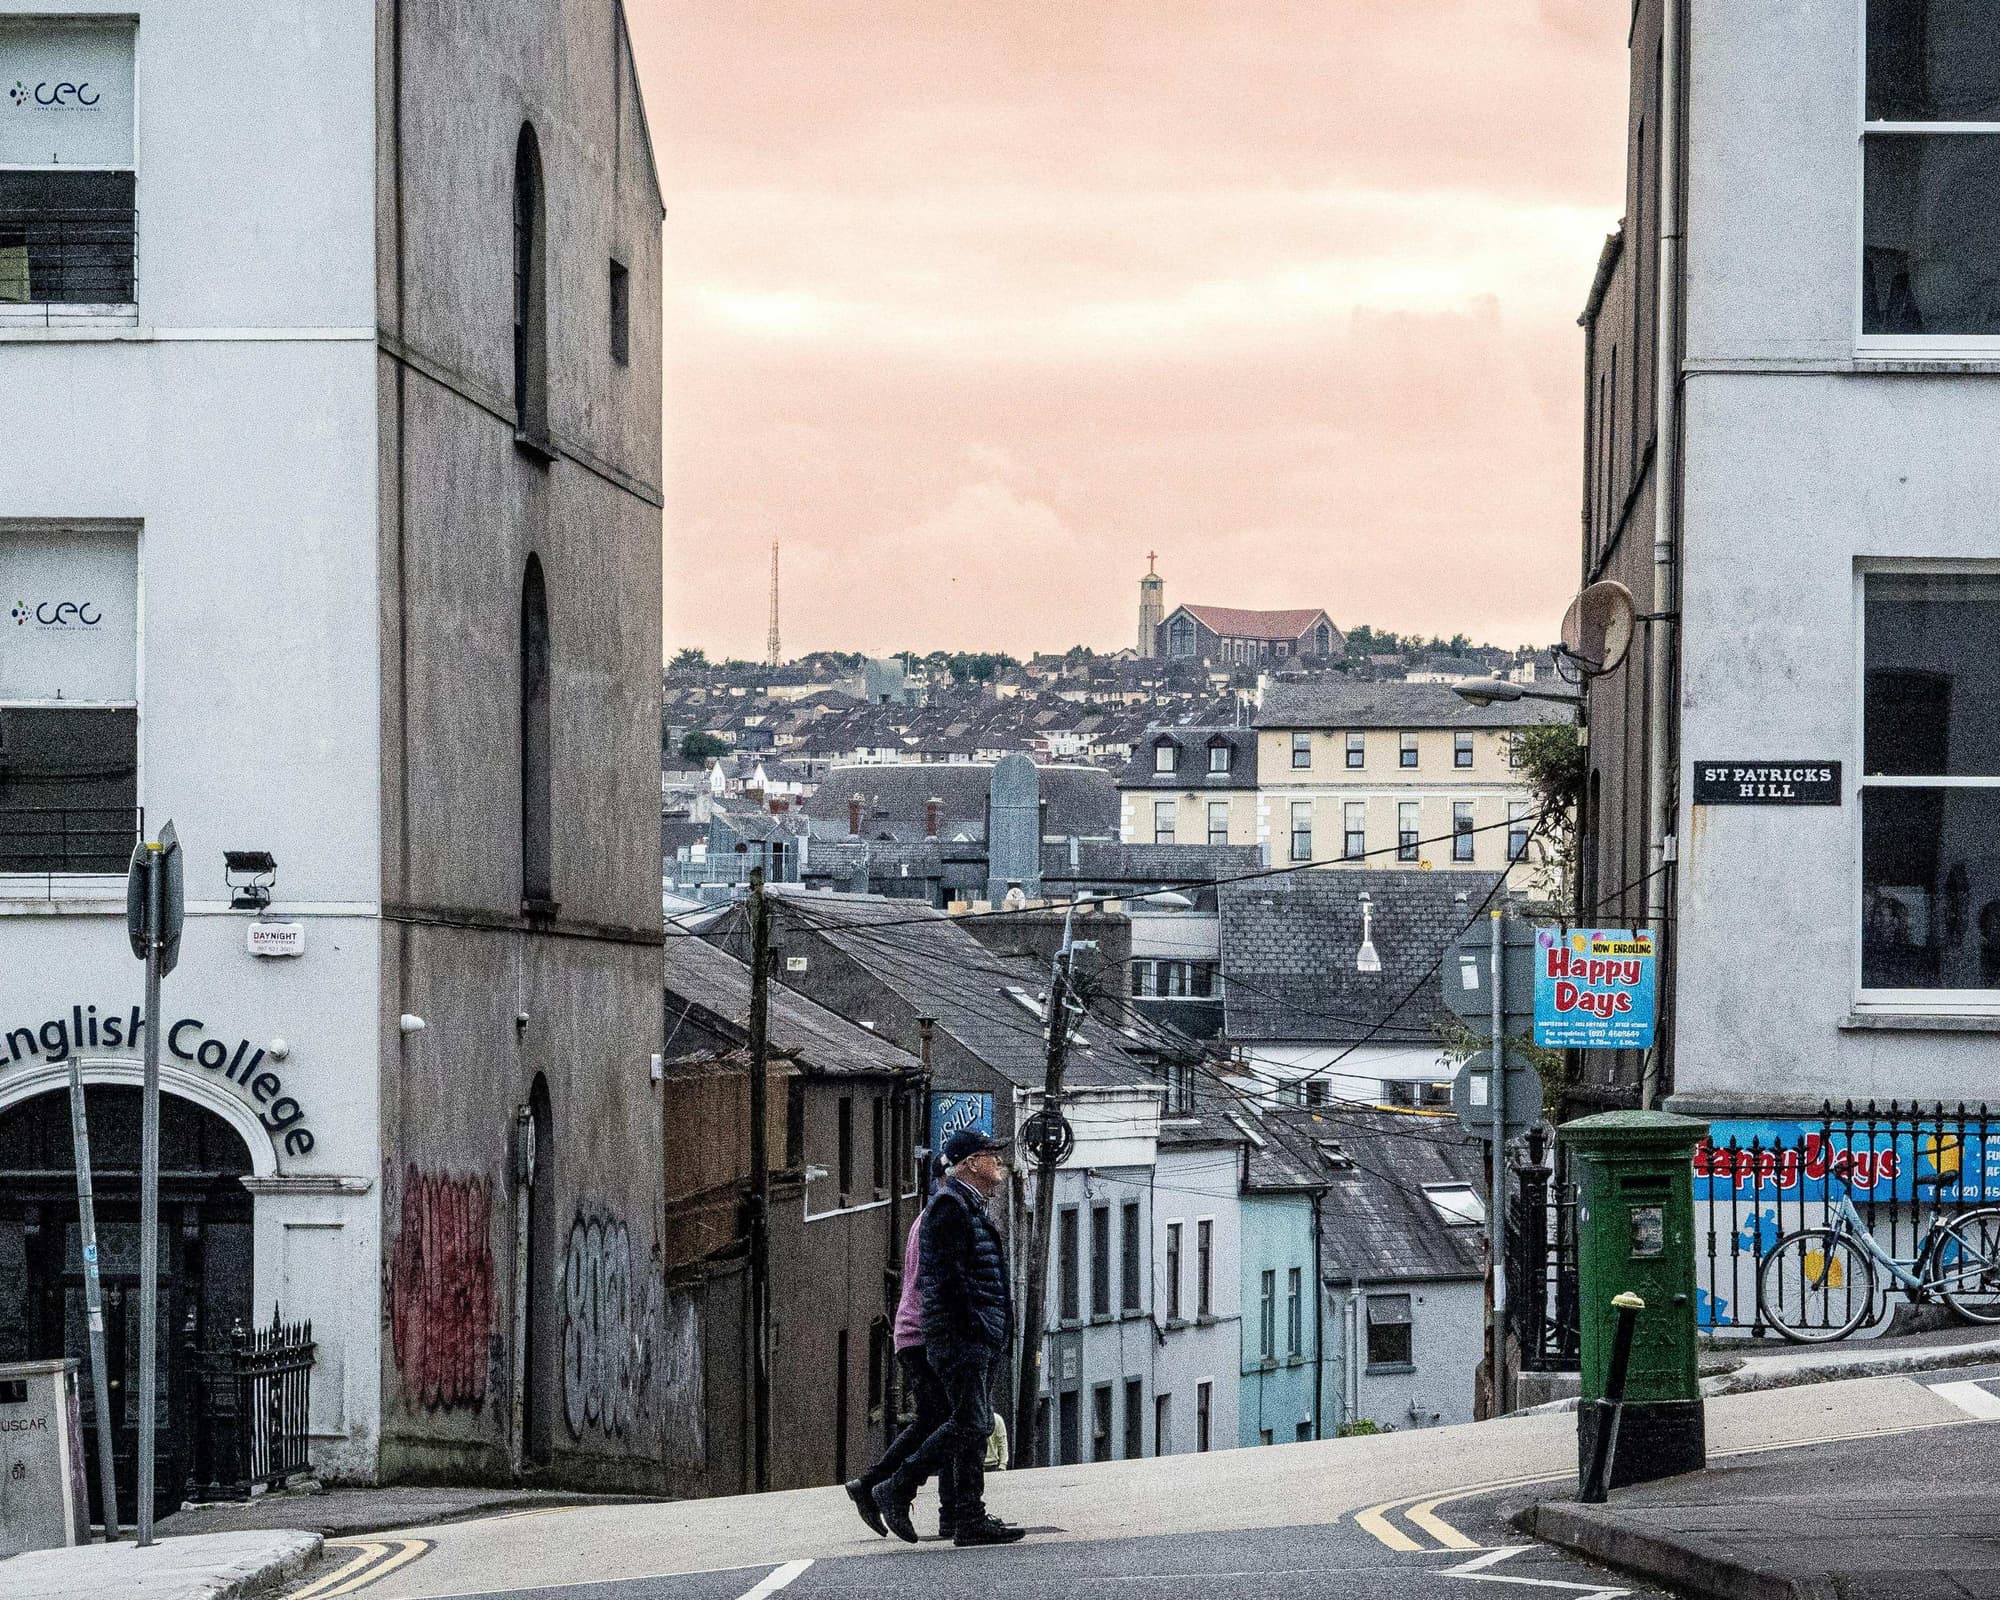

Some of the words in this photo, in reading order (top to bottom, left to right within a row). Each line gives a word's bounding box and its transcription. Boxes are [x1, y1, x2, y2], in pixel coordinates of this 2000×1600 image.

[1705, 768, 1728, 782] ST
[1733, 768, 1832, 782] PATRICKS
[1739, 784, 1795, 797] HILL
[253, 931, 297, 940] DAYNIGHT
[1592, 943, 1610, 953] NOW
[1614, 943, 1652, 954] ENROLLING
[1547, 947, 1641, 985] Happy
[1555, 981, 1632, 1018] Days
[0, 1004, 146, 1066] nglish
[167, 1018, 315, 1157] College
[938, 1095, 957, 1115] THE
[939, 1095, 983, 1152] ASHLEY
[1805, 1132, 1900, 1190] Days
